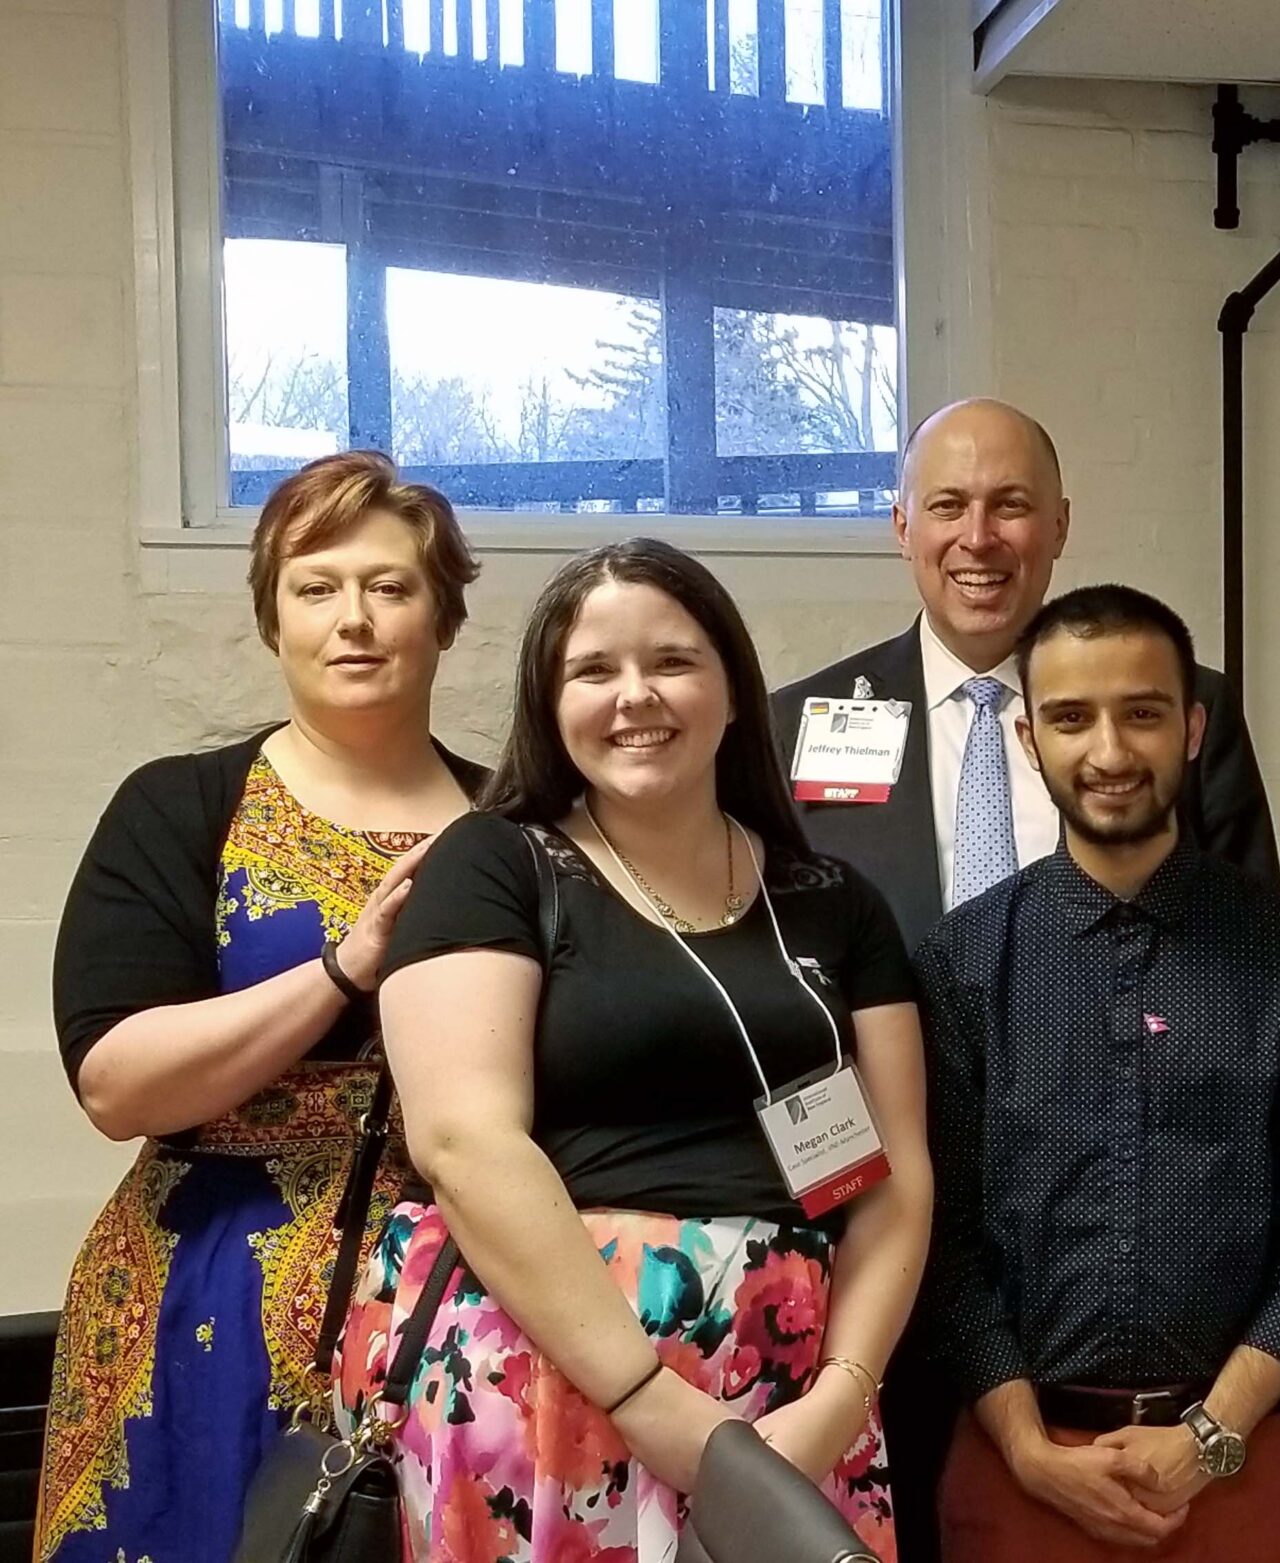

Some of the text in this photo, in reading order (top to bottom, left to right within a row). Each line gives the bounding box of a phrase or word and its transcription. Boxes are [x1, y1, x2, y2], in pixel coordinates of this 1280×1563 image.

[808, 744, 890, 756] Jeffrey Thielman
[824, 787, 859, 799] STAFF
[793, 1132, 829, 1154] Megan
[829, 1118, 856, 1136] Clark
[832, 1175, 864, 1200] STAFF
